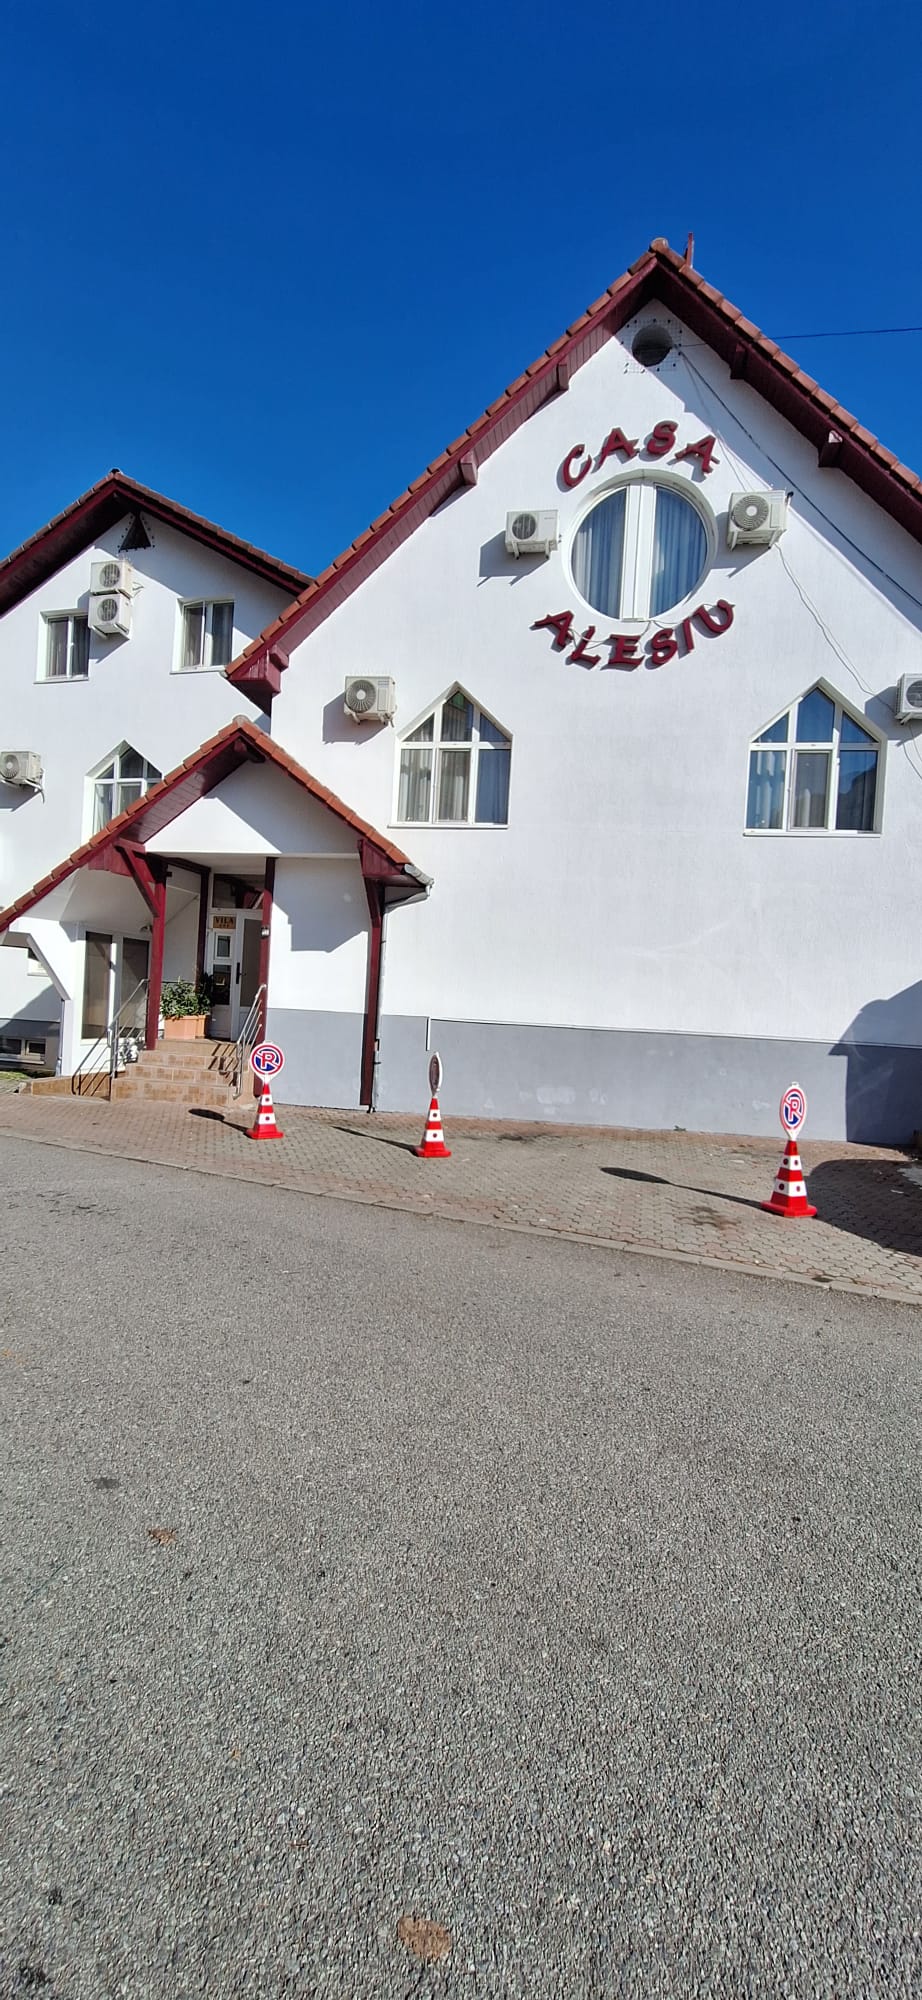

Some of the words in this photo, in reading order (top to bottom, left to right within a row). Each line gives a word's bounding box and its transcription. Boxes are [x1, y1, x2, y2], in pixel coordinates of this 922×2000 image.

[562, 420, 720, 487] CASA
[534, 599, 735, 666] ALESIU
[214, 916, 234, 924] VILA
